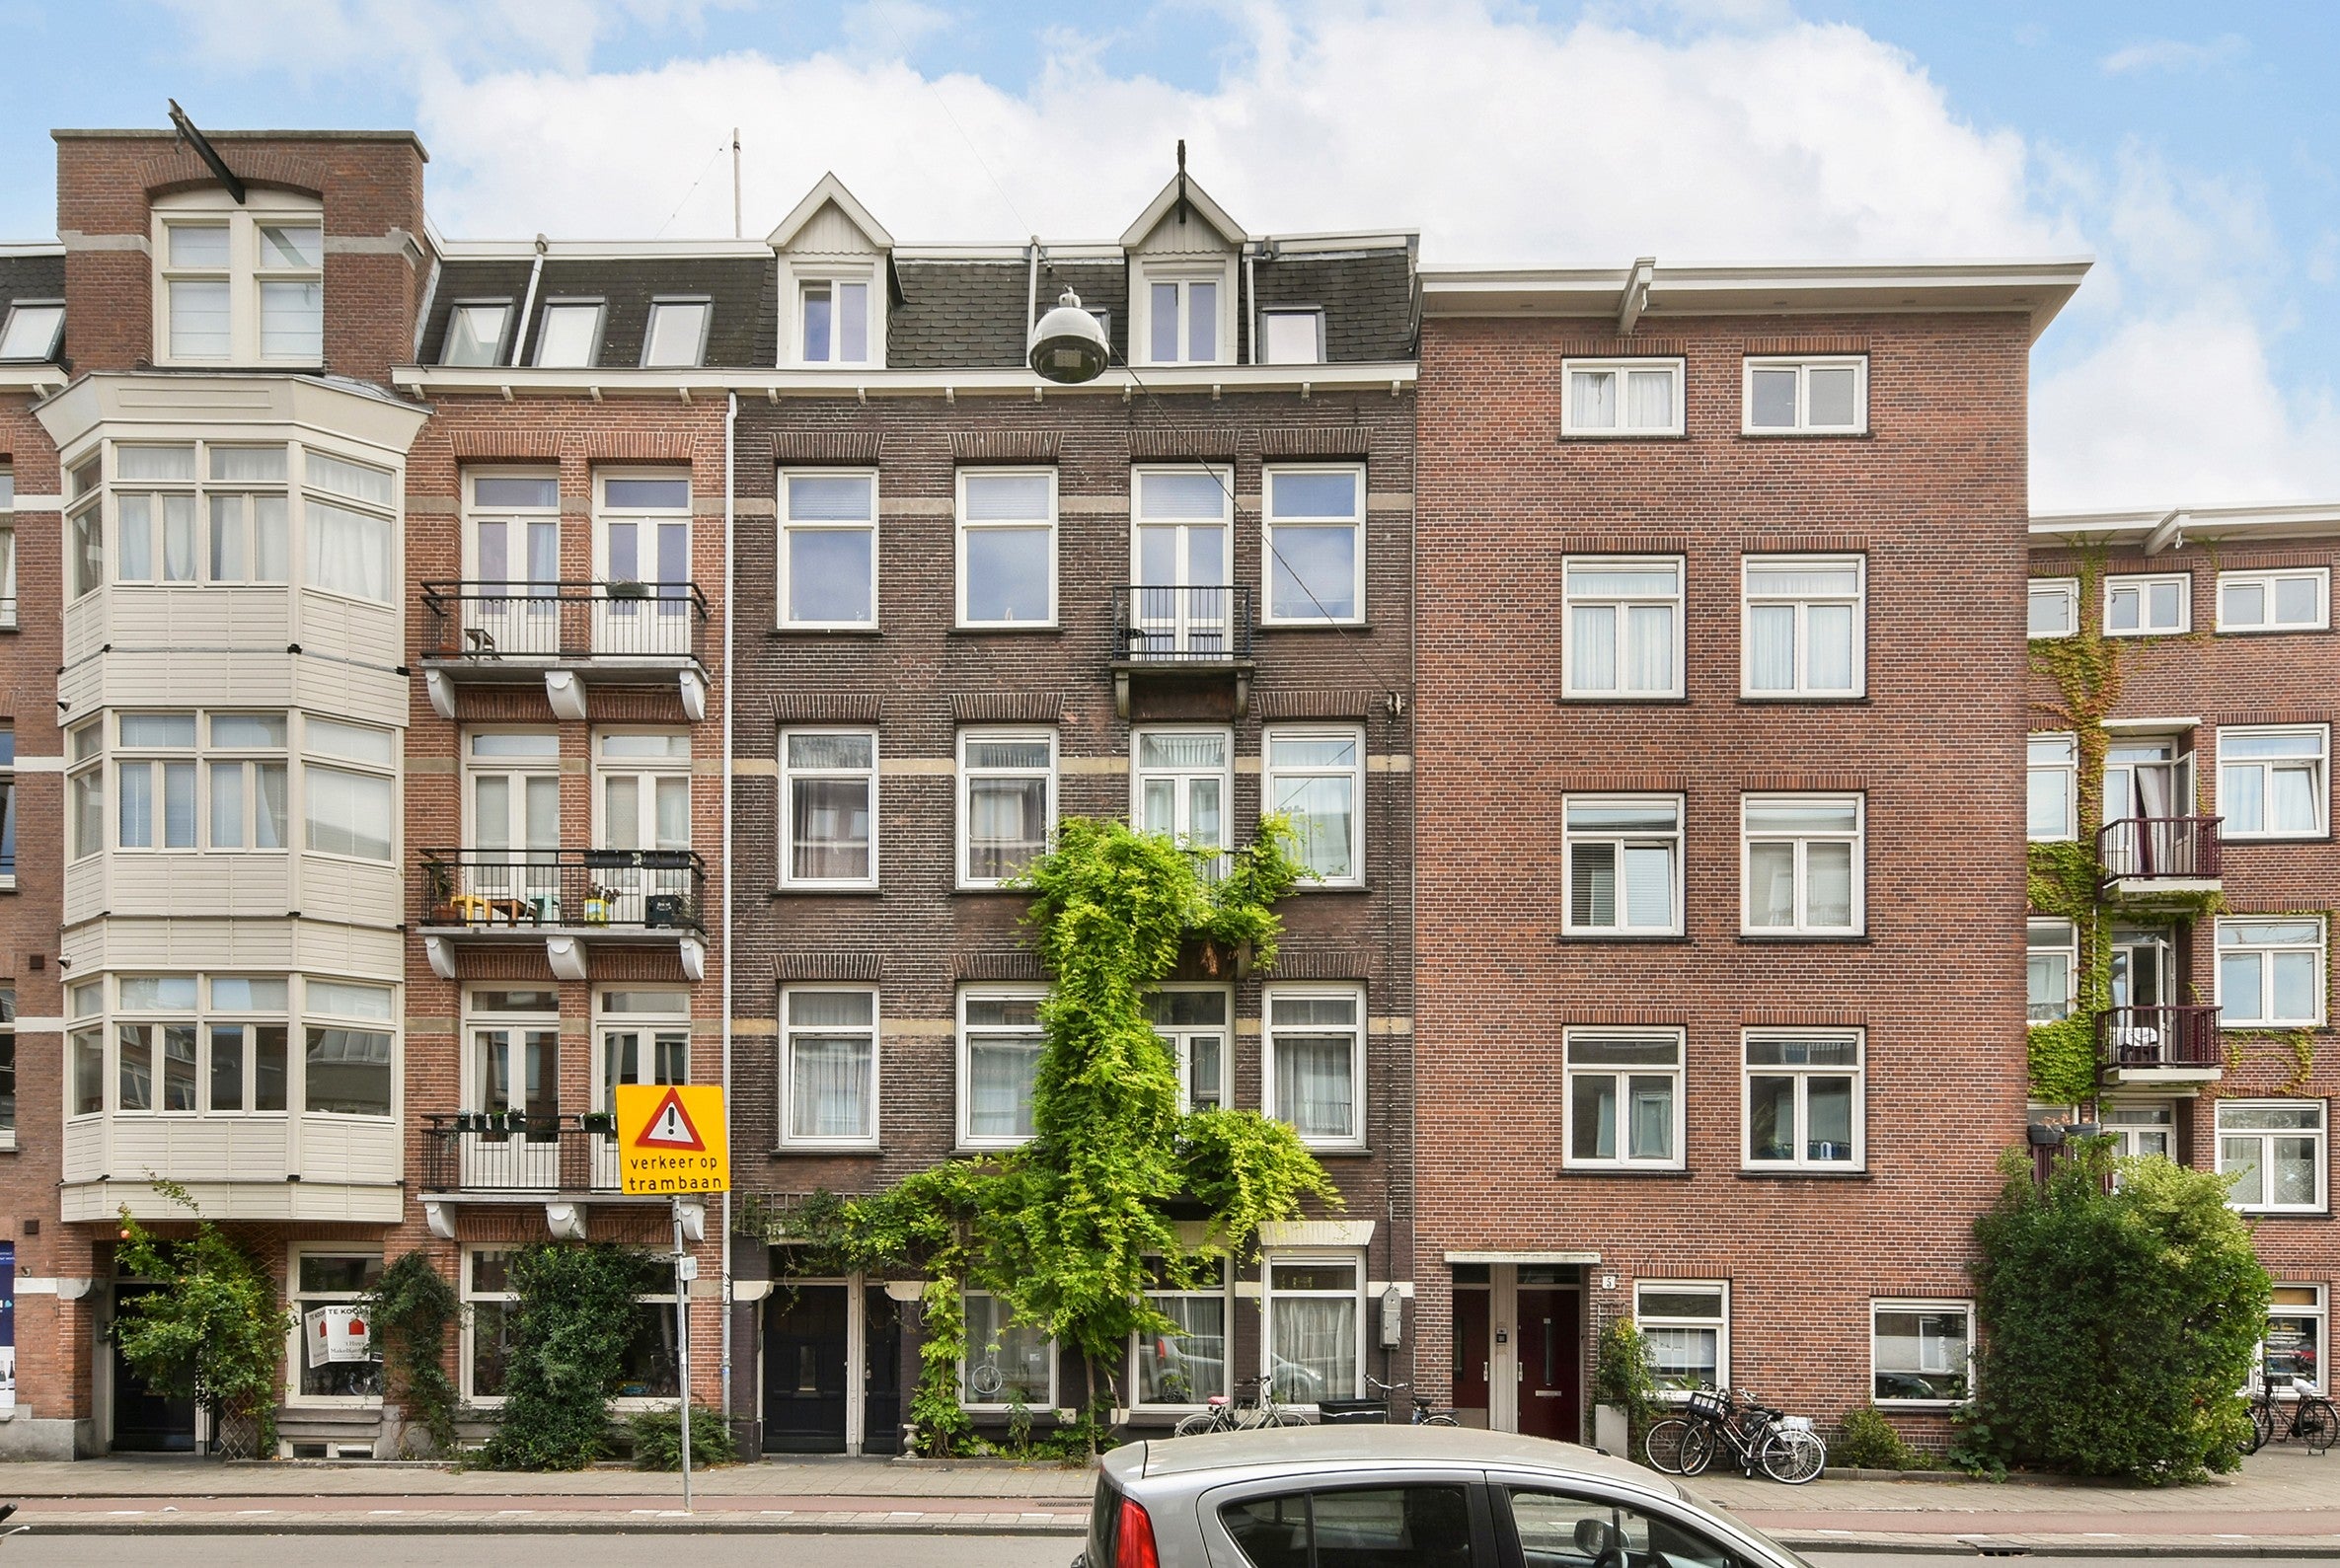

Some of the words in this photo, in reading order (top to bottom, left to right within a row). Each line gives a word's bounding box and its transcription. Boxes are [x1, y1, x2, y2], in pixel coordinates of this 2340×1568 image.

[631, 1156, 694, 1170] verkeer
[700, 1157, 717, 1170] op
[629, 1175, 721, 1191] trambaan
